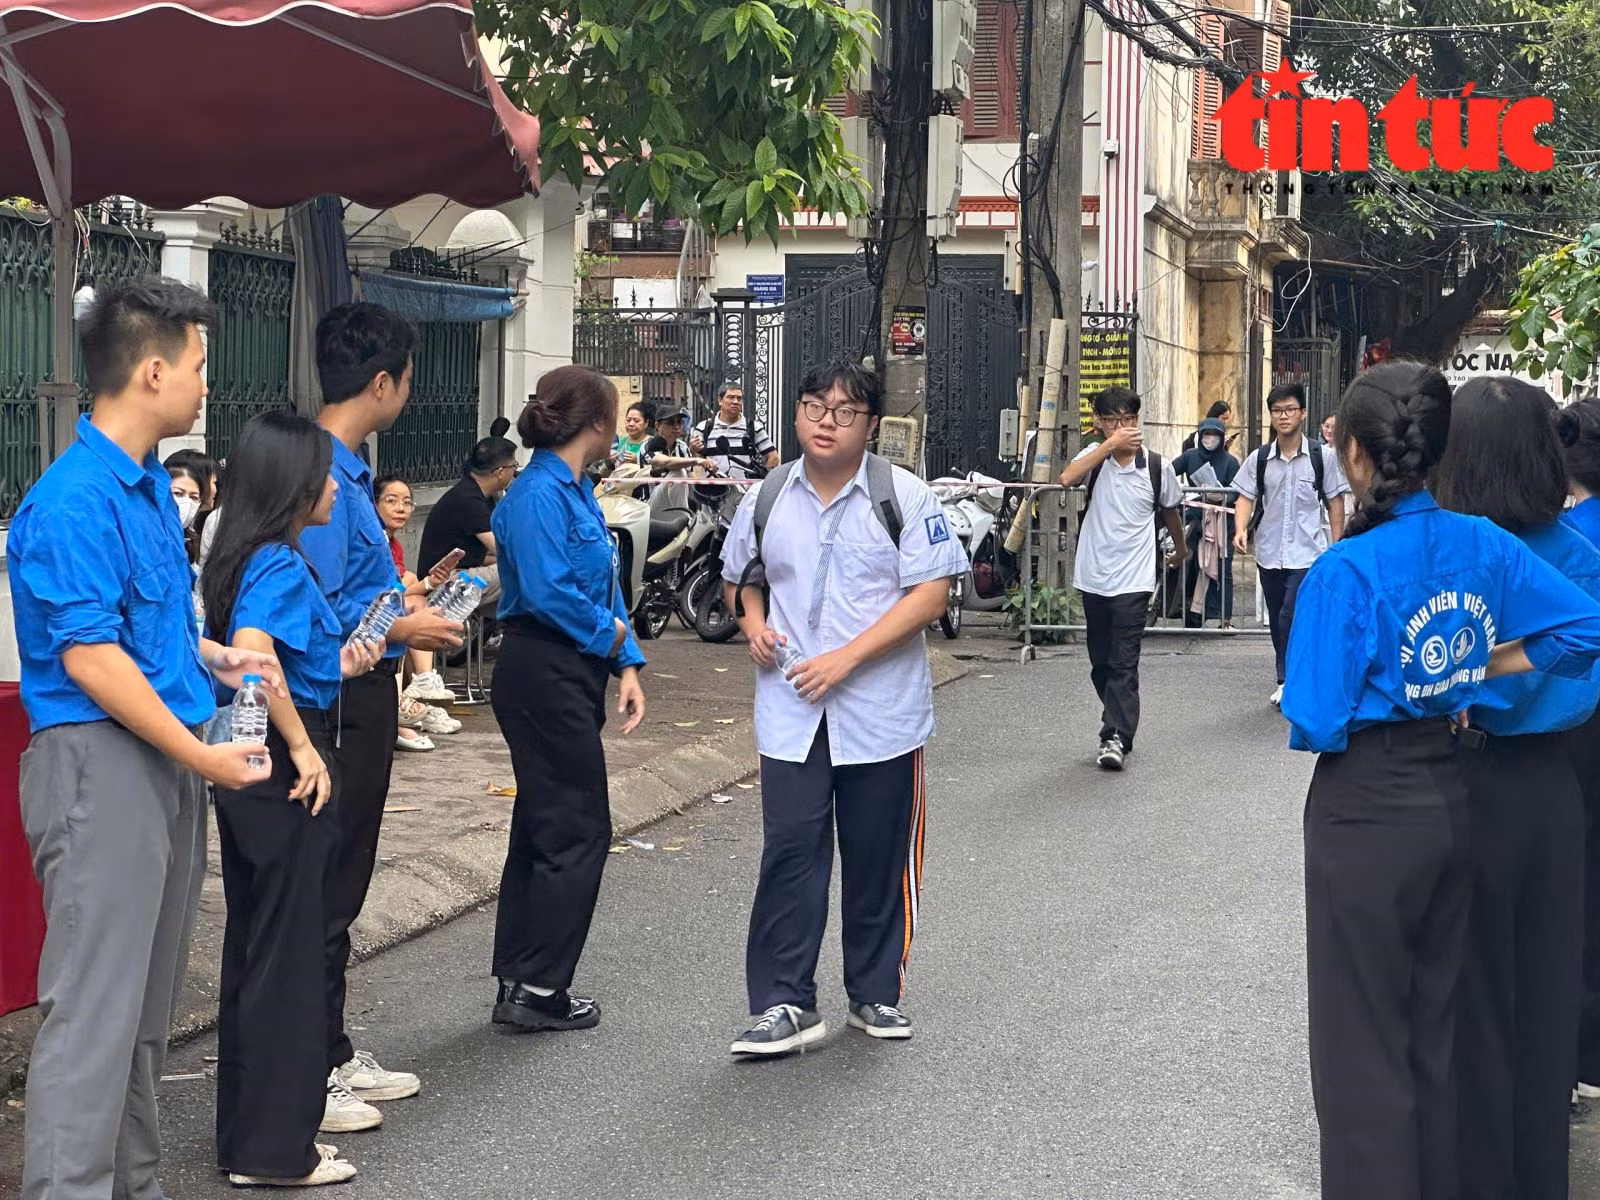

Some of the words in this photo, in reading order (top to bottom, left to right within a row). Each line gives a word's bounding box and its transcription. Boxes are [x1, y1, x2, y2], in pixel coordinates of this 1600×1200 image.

[1486, 353, 1519, 371] NA
[1428, 590, 1458, 615] VIÊN
[1464, 592, 1487, 619] VIỆT
